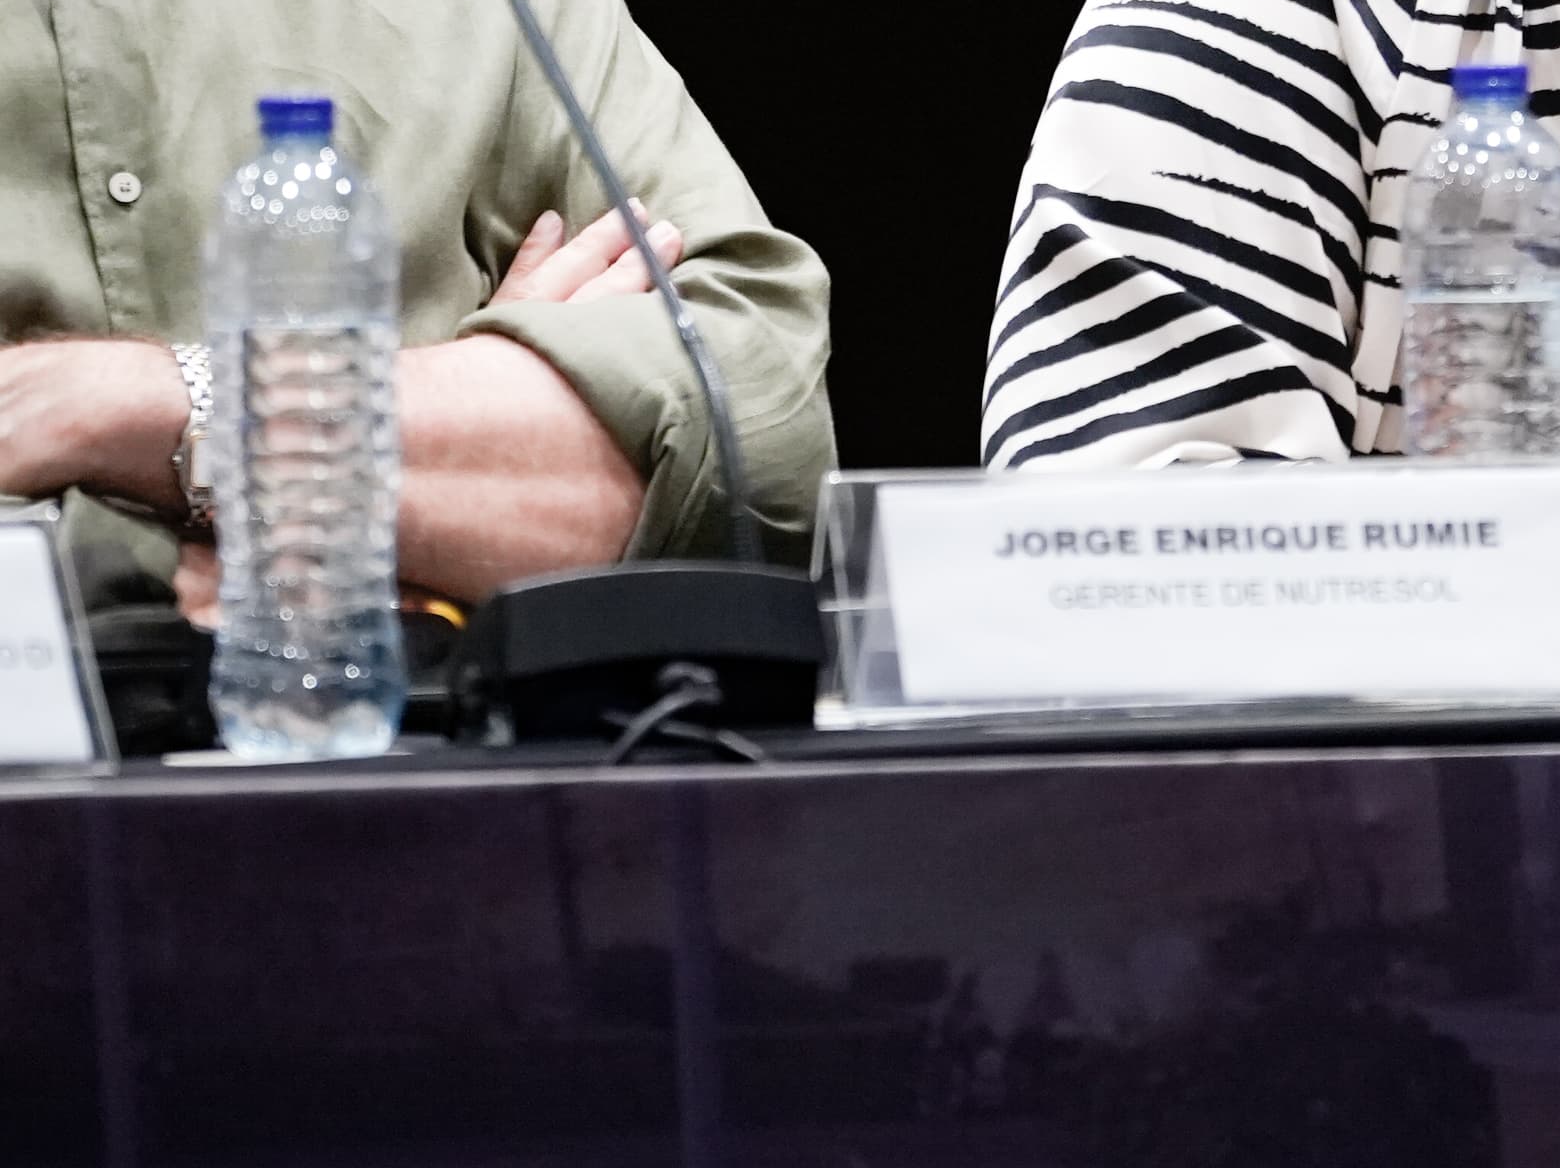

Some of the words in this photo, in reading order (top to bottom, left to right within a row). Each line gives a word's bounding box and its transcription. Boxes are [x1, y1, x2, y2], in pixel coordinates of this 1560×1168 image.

[996, 527, 1139, 558] JORGE
[1155, 523, 1348, 554] ENRIQUE
[1361, 520, 1498, 550] RUMIE
[1049, 582, 1209, 610] GERENTE
[1221, 580, 1264, 607] DE
[1275, 577, 1459, 607] NUTRESOL
